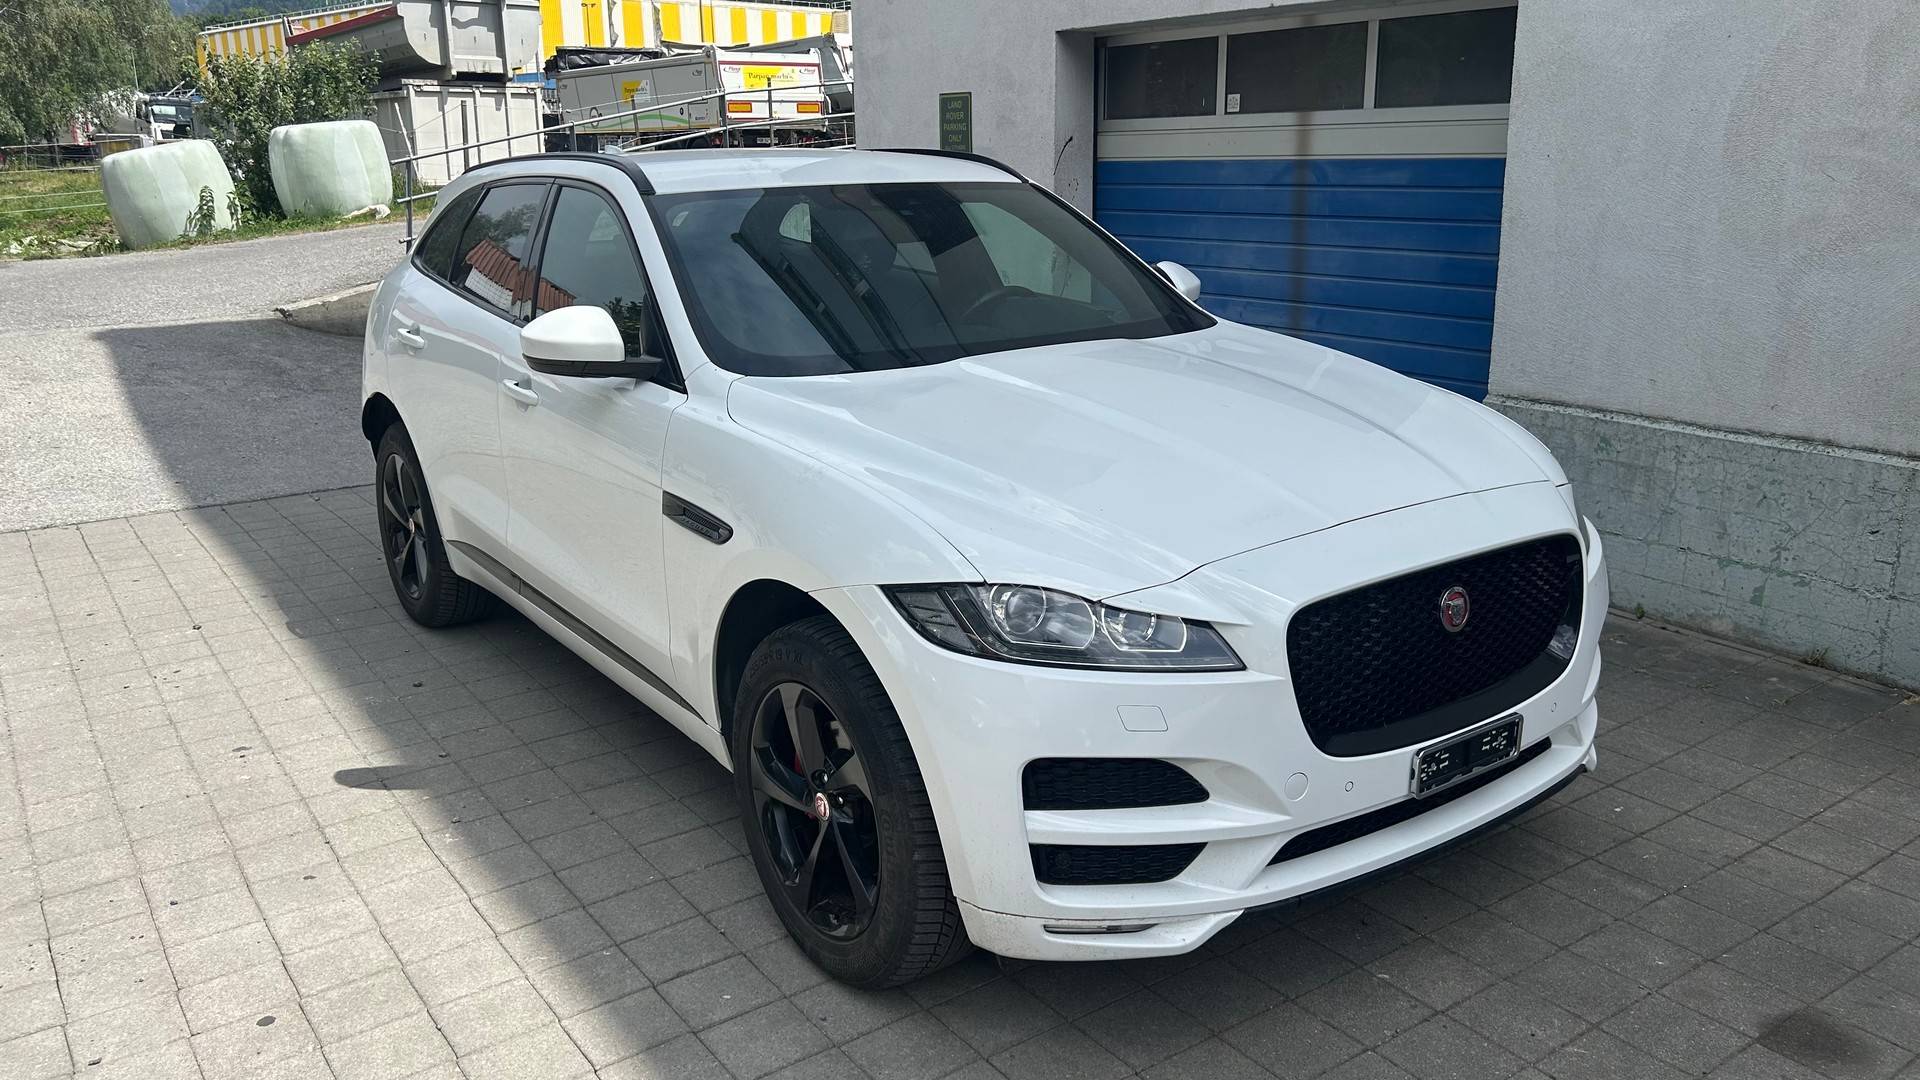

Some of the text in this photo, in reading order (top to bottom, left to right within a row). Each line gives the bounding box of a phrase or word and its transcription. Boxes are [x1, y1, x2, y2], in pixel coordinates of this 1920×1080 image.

[947, 101, 962, 109] LAND
[945, 112, 964, 120] ROVER
[943, 123, 967, 131] PARKING
[948, 134, 962, 142] ONLY
[680, 517, 710, 536] JAGUAR
[794, 650, 804, 666] XL
